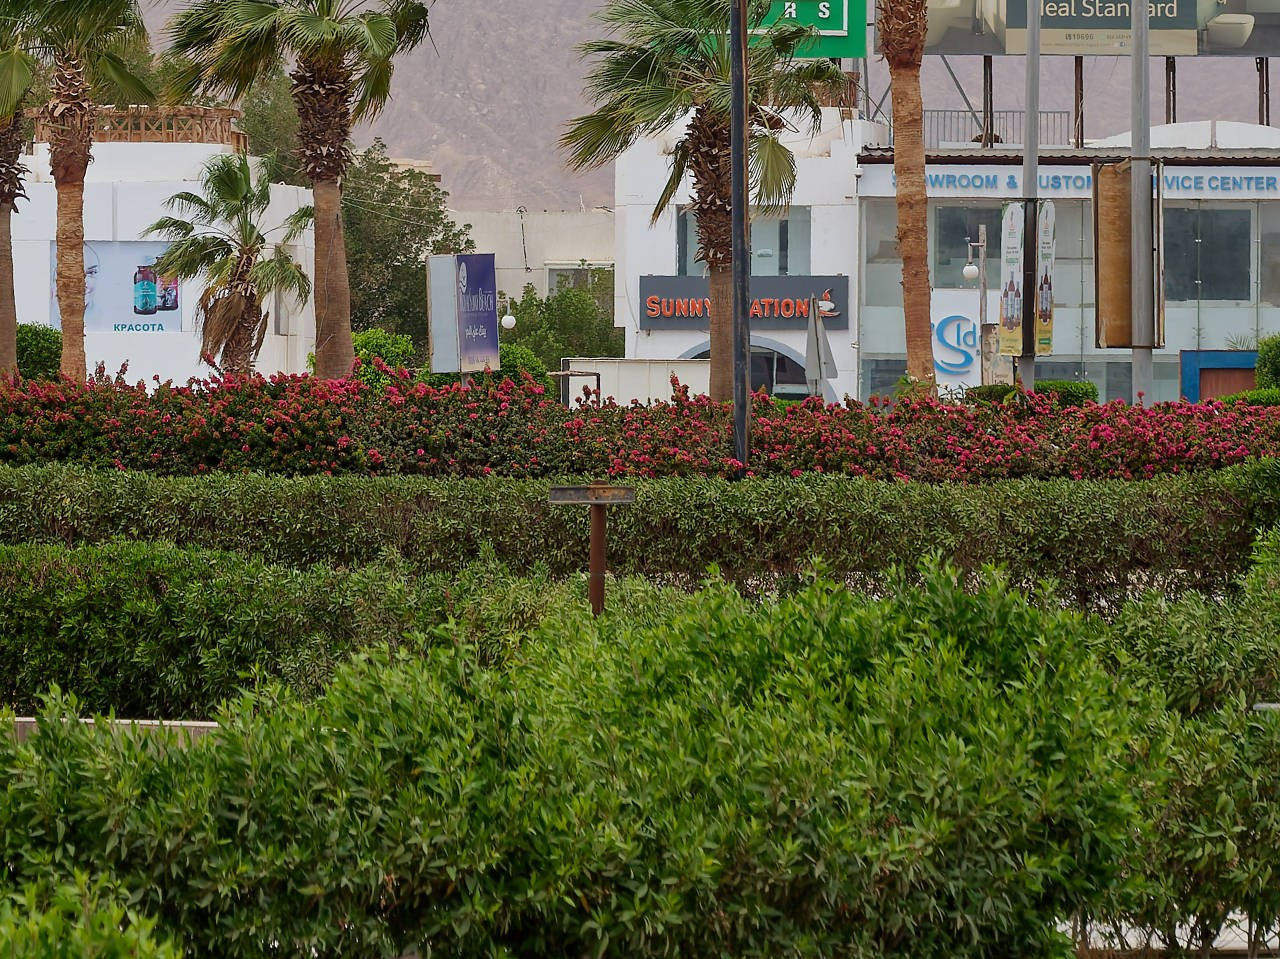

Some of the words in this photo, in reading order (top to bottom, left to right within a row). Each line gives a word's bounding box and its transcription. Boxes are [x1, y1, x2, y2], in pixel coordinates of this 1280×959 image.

[1006, 174, 1018, 189] &
[1207, 176, 1277, 191] CENTER
[646, 296, 711, 318] SUNNY
[113, 323, 164, 332] КРАСОТА
